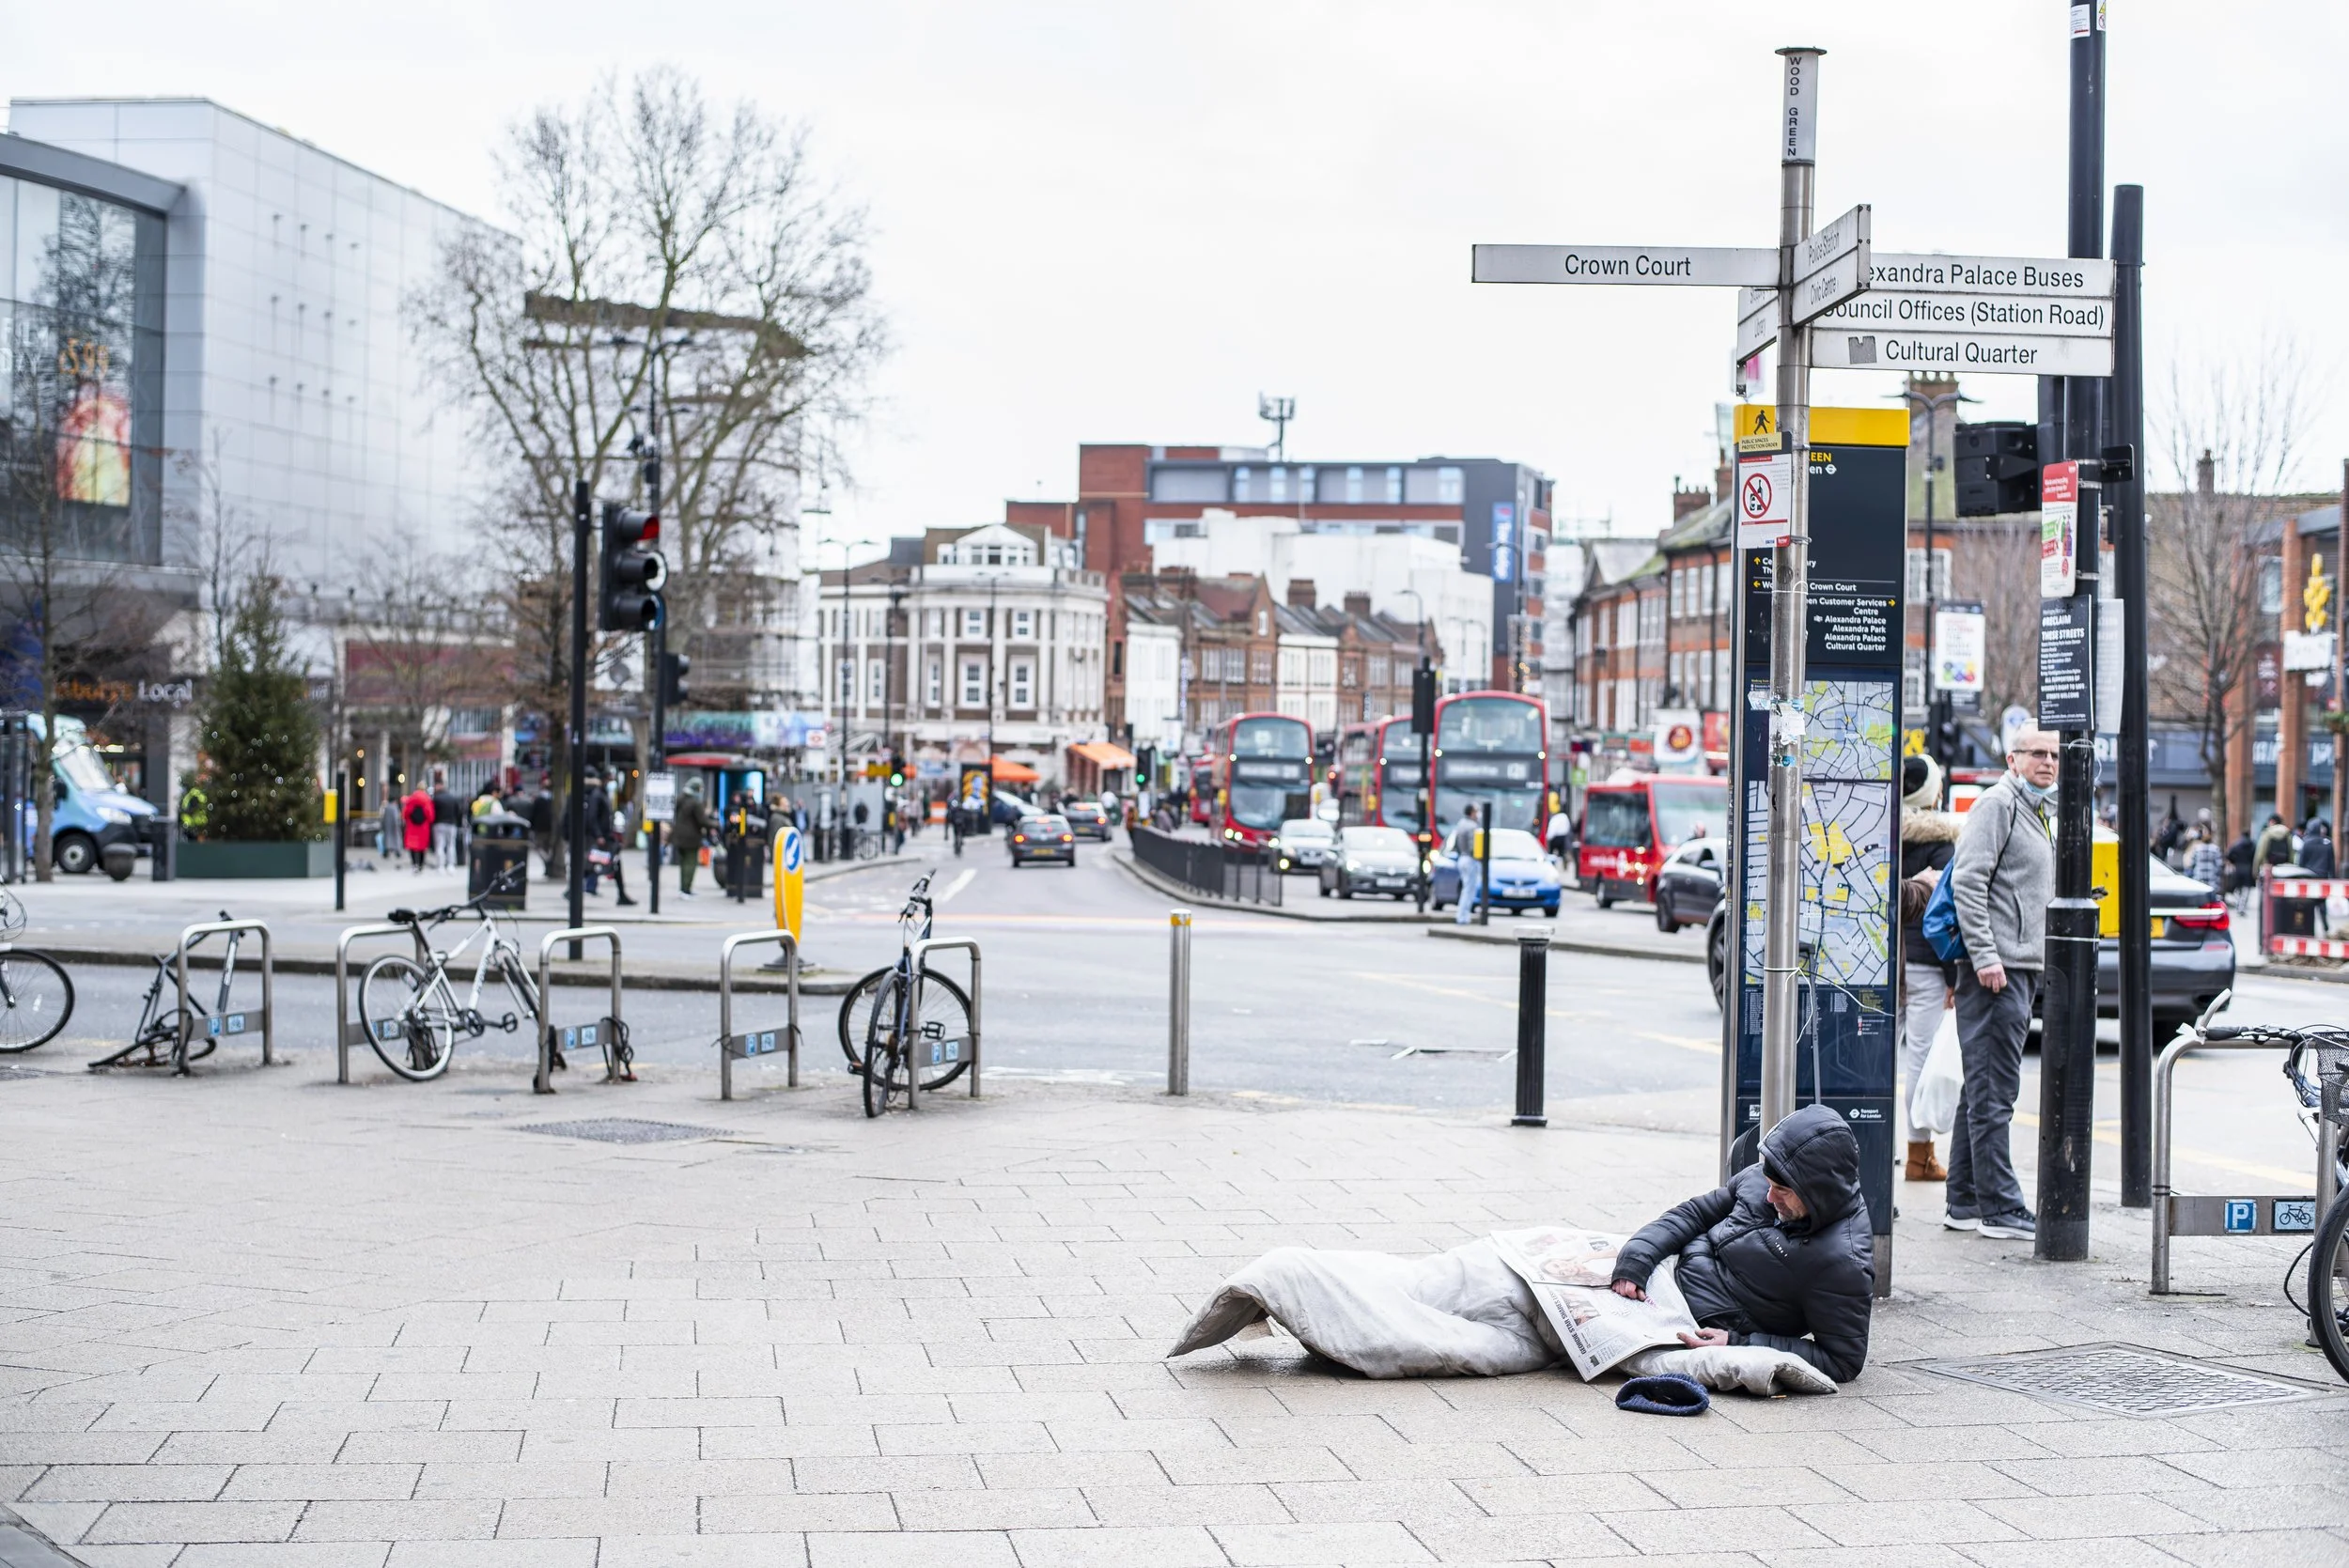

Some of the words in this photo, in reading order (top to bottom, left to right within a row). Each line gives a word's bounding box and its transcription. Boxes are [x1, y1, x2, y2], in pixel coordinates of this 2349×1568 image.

[1789, 56, 1802, 96] WOOD
[1787, 107, 1798, 156] GREEN
[1564, 254, 1628, 275] Crown
[1636, 255, 1691, 276] Court
[1869, 263, 1945, 284] exandra
[1951, 264, 2017, 287] Palace
[2024, 266, 2084, 288] Buses
[1899, 299, 1965, 321] Offices
[1971, 302, 2043, 327] (Station
[2049, 303, 2104, 331] Road)
[1886, 339, 1959, 362] Cultural
[1965, 342, 2038, 365] Quarter
[1810, 451, 1832, 463] EEN
[1810, 582, 1834, 591] Crown
[1835, 582, 1857, 592] Court
[1819, 597, 1855, 606] Customer
[1857, 598, 1887, 607] Services
[1825, 614, 1861, 624] Alexandra
[1862, 616, 1887, 625] Palace
[1853, 607, 1879, 615] Centre
[1832, 624, 1869, 633] Alexandra
[1870, 625, 1886, 633] Park
[1824, 632, 1861, 642] Alexandra
[1862, 634, 1887, 643] Palace
[1826, 642, 1856, 651] Cultural
[1857, 643, 1886, 651] Quarter
[138, 678, 193, 704] Local
[2232, 1203, 2249, 1229] P
